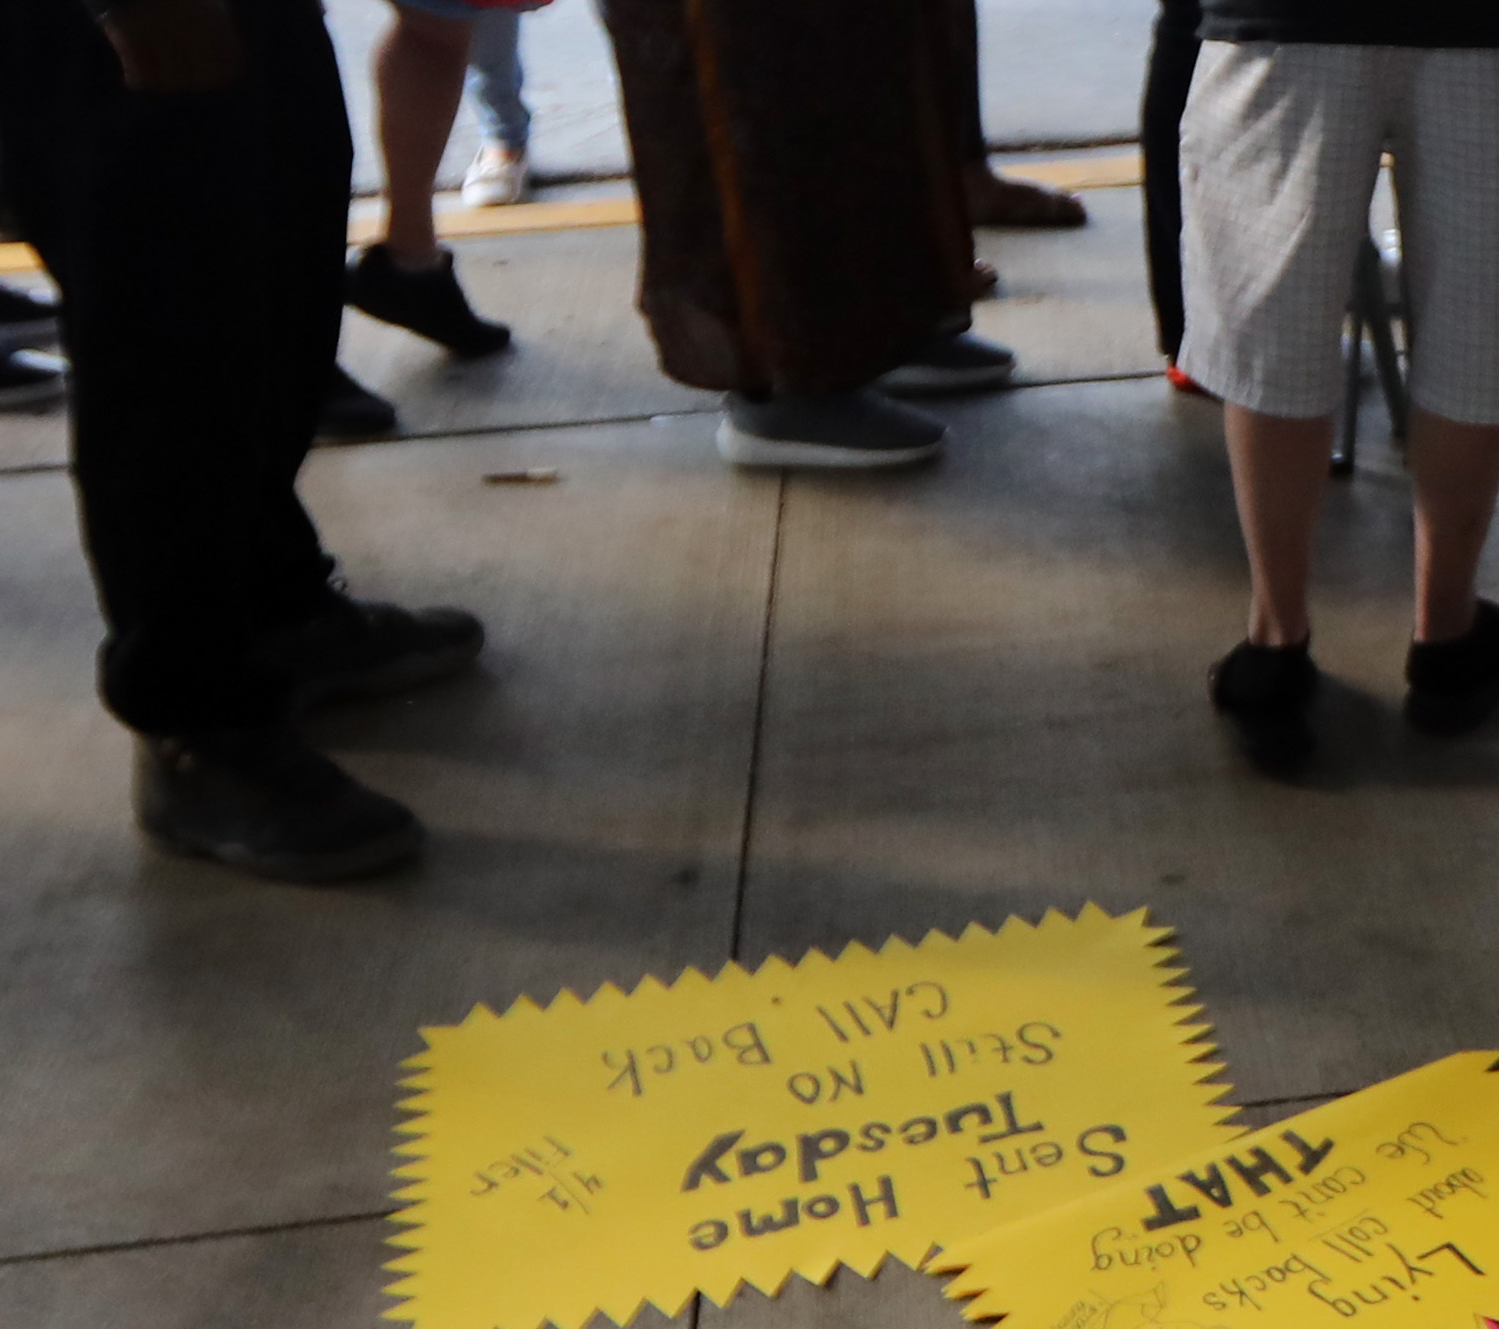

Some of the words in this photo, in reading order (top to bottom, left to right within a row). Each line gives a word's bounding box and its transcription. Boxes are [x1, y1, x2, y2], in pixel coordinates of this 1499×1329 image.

[598, 1020, 770, 1097] Back
[918, 1021, 1060, 1076] Still
[785, 1059, 863, 1104] NO
[468, 1135, 570, 1196] Filer
[678, 1090, 1044, 1192] Tuesday
[962, 1123, 1126, 1199] Sent
[536, 1172, 601, 1215] 4/1
[686, 1174, 897, 1250] Home
[1277, 1165, 1365, 1222] can't
[1404, 1166, 1486, 1218] about
[1089, 1227, 1200, 1270] doing
[1221, 1209, 1278, 1243] be
[1320, 1216, 1387, 1261] call
[1201, 1253, 1331, 1310] backs
[1306, 1242, 1485, 1317] Lying
